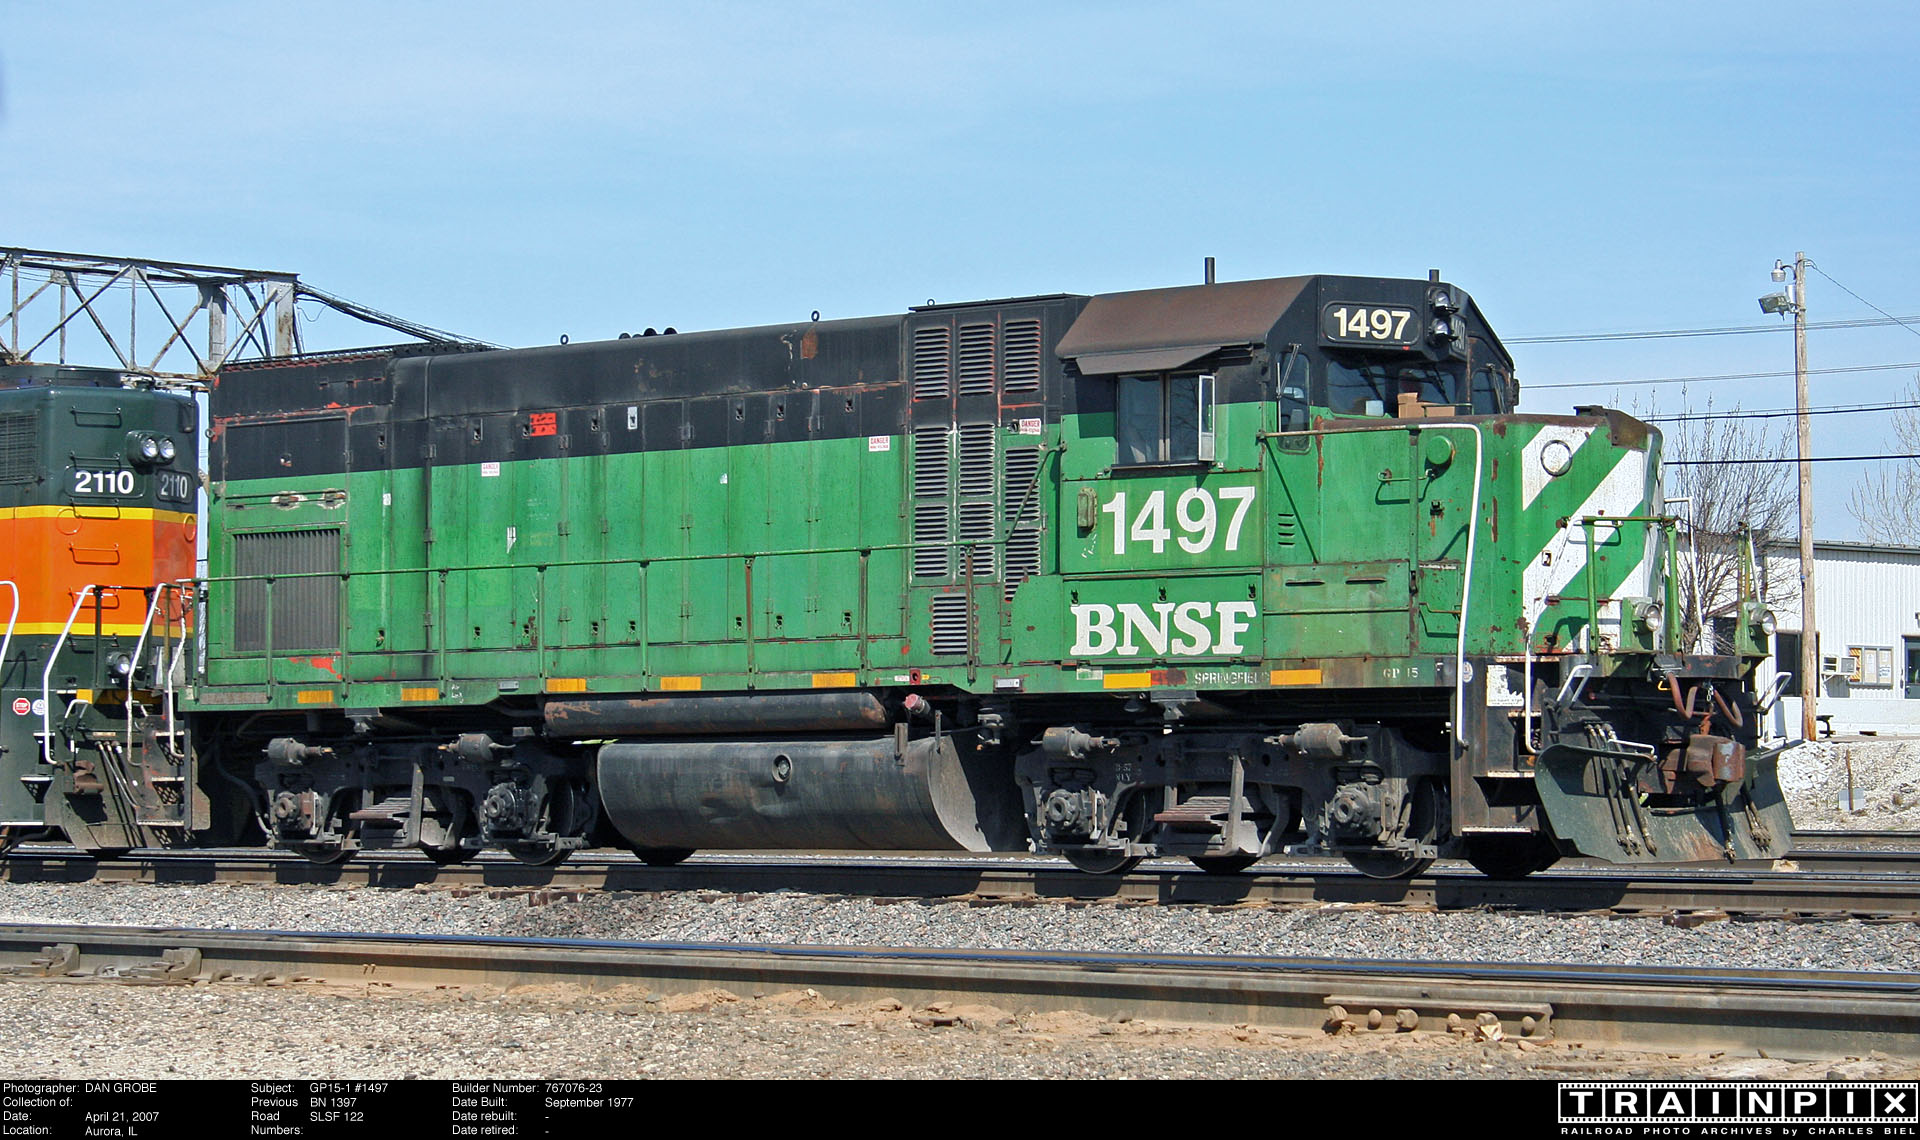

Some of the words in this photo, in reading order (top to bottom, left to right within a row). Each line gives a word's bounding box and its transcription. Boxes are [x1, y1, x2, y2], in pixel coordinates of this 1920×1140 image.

[1334, 308, 1411, 340] 1497
[75, 471, 134, 494] 2110
[161, 474, 188, 498] 2110
[1102, 486, 1256, 555] 1497
[1070, 601, 1257, 656] BNSF
